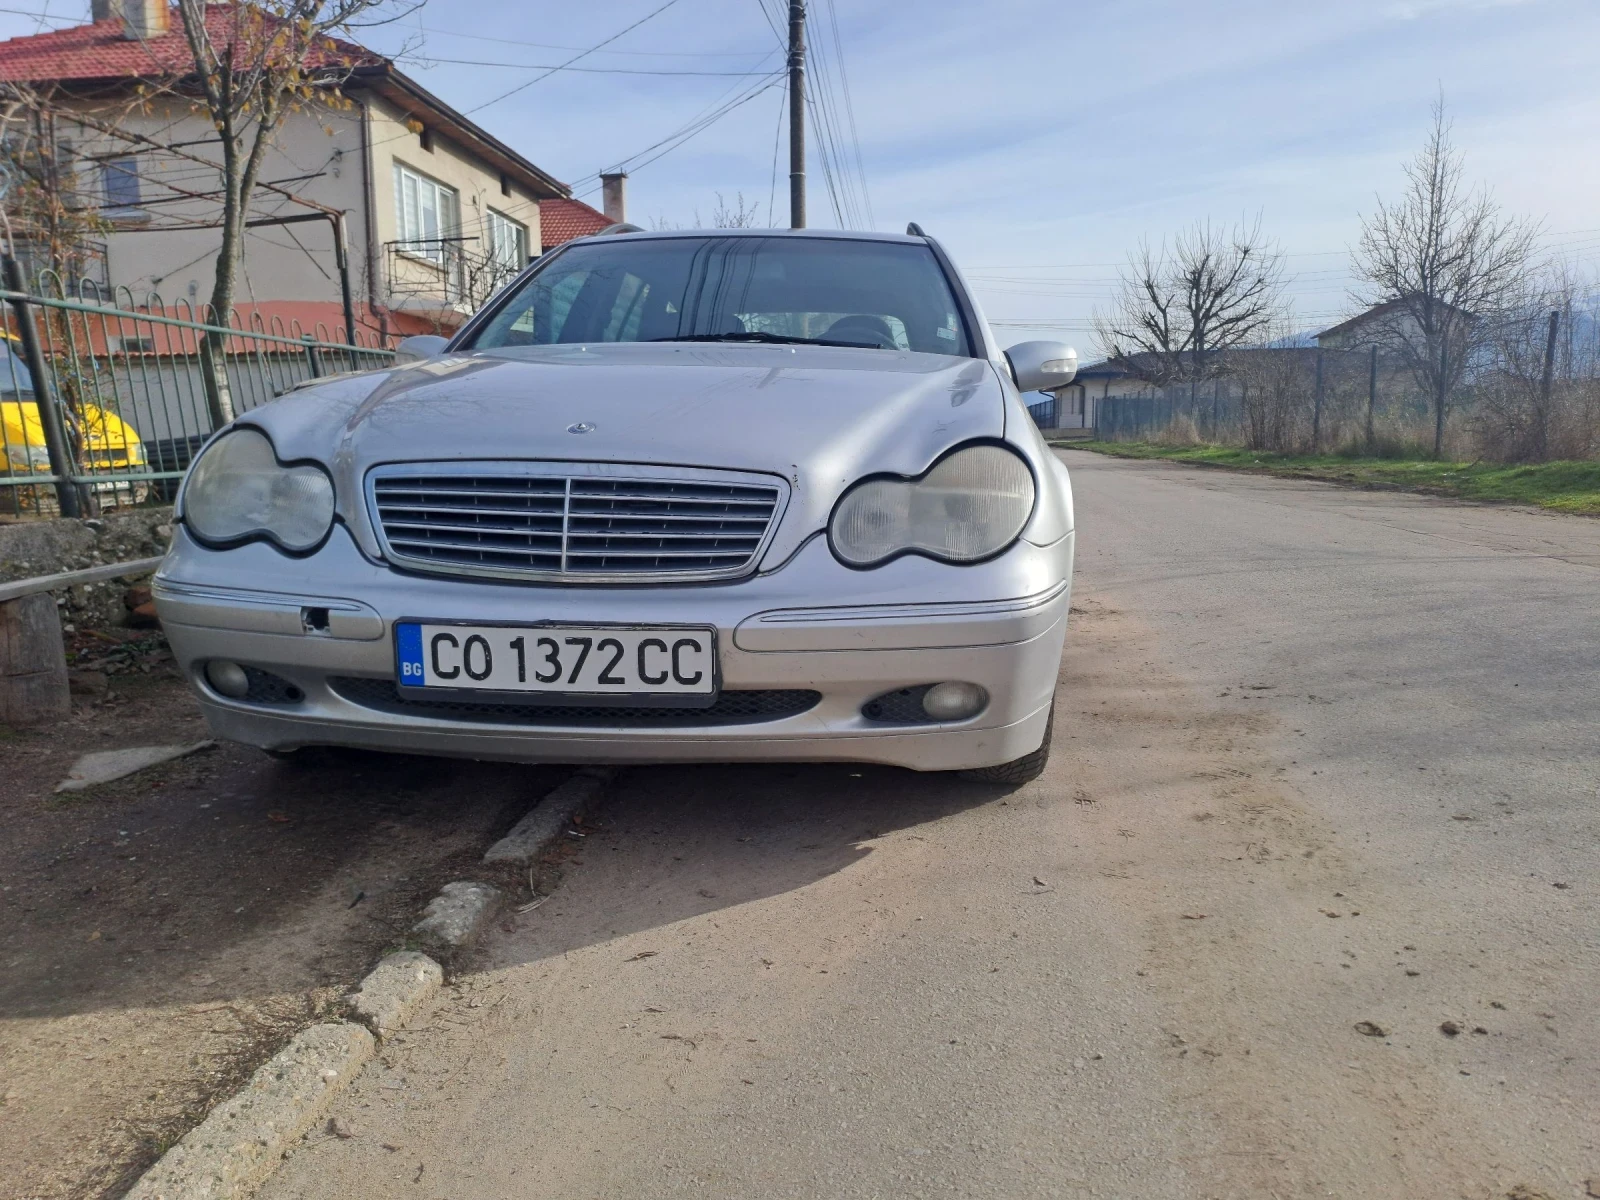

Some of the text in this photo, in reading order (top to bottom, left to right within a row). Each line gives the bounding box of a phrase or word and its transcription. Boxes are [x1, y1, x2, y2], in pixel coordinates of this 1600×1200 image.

[402, 662, 422, 676] BG
[509, 635, 626, 685] 1372
[637, 638, 703, 686] CC
